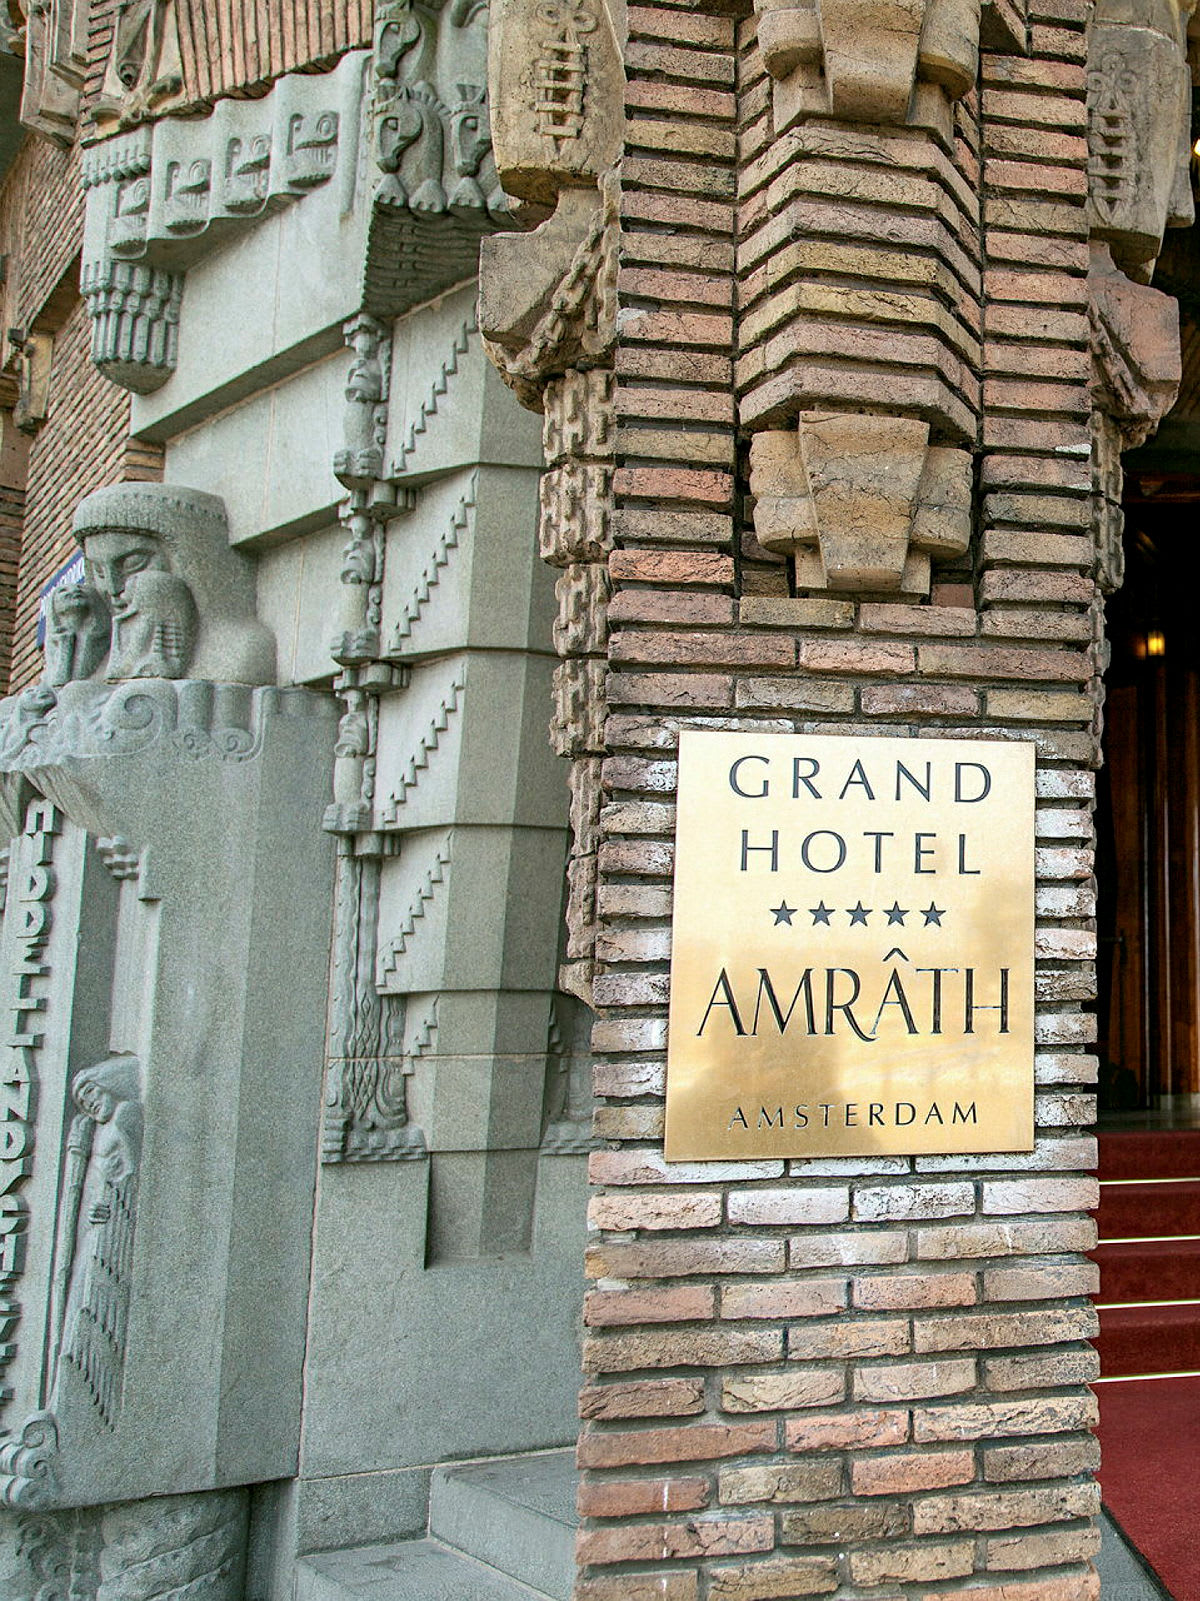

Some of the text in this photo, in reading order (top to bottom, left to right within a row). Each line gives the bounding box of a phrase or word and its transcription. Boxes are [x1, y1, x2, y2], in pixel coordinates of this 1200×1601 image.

[729, 755, 993, 803] GRAND
[740, 829, 982, 875] HOTEL
[696, 948, 1010, 1042] AMRÂTH
[728, 1101, 978, 1130] AMSTERDAM
